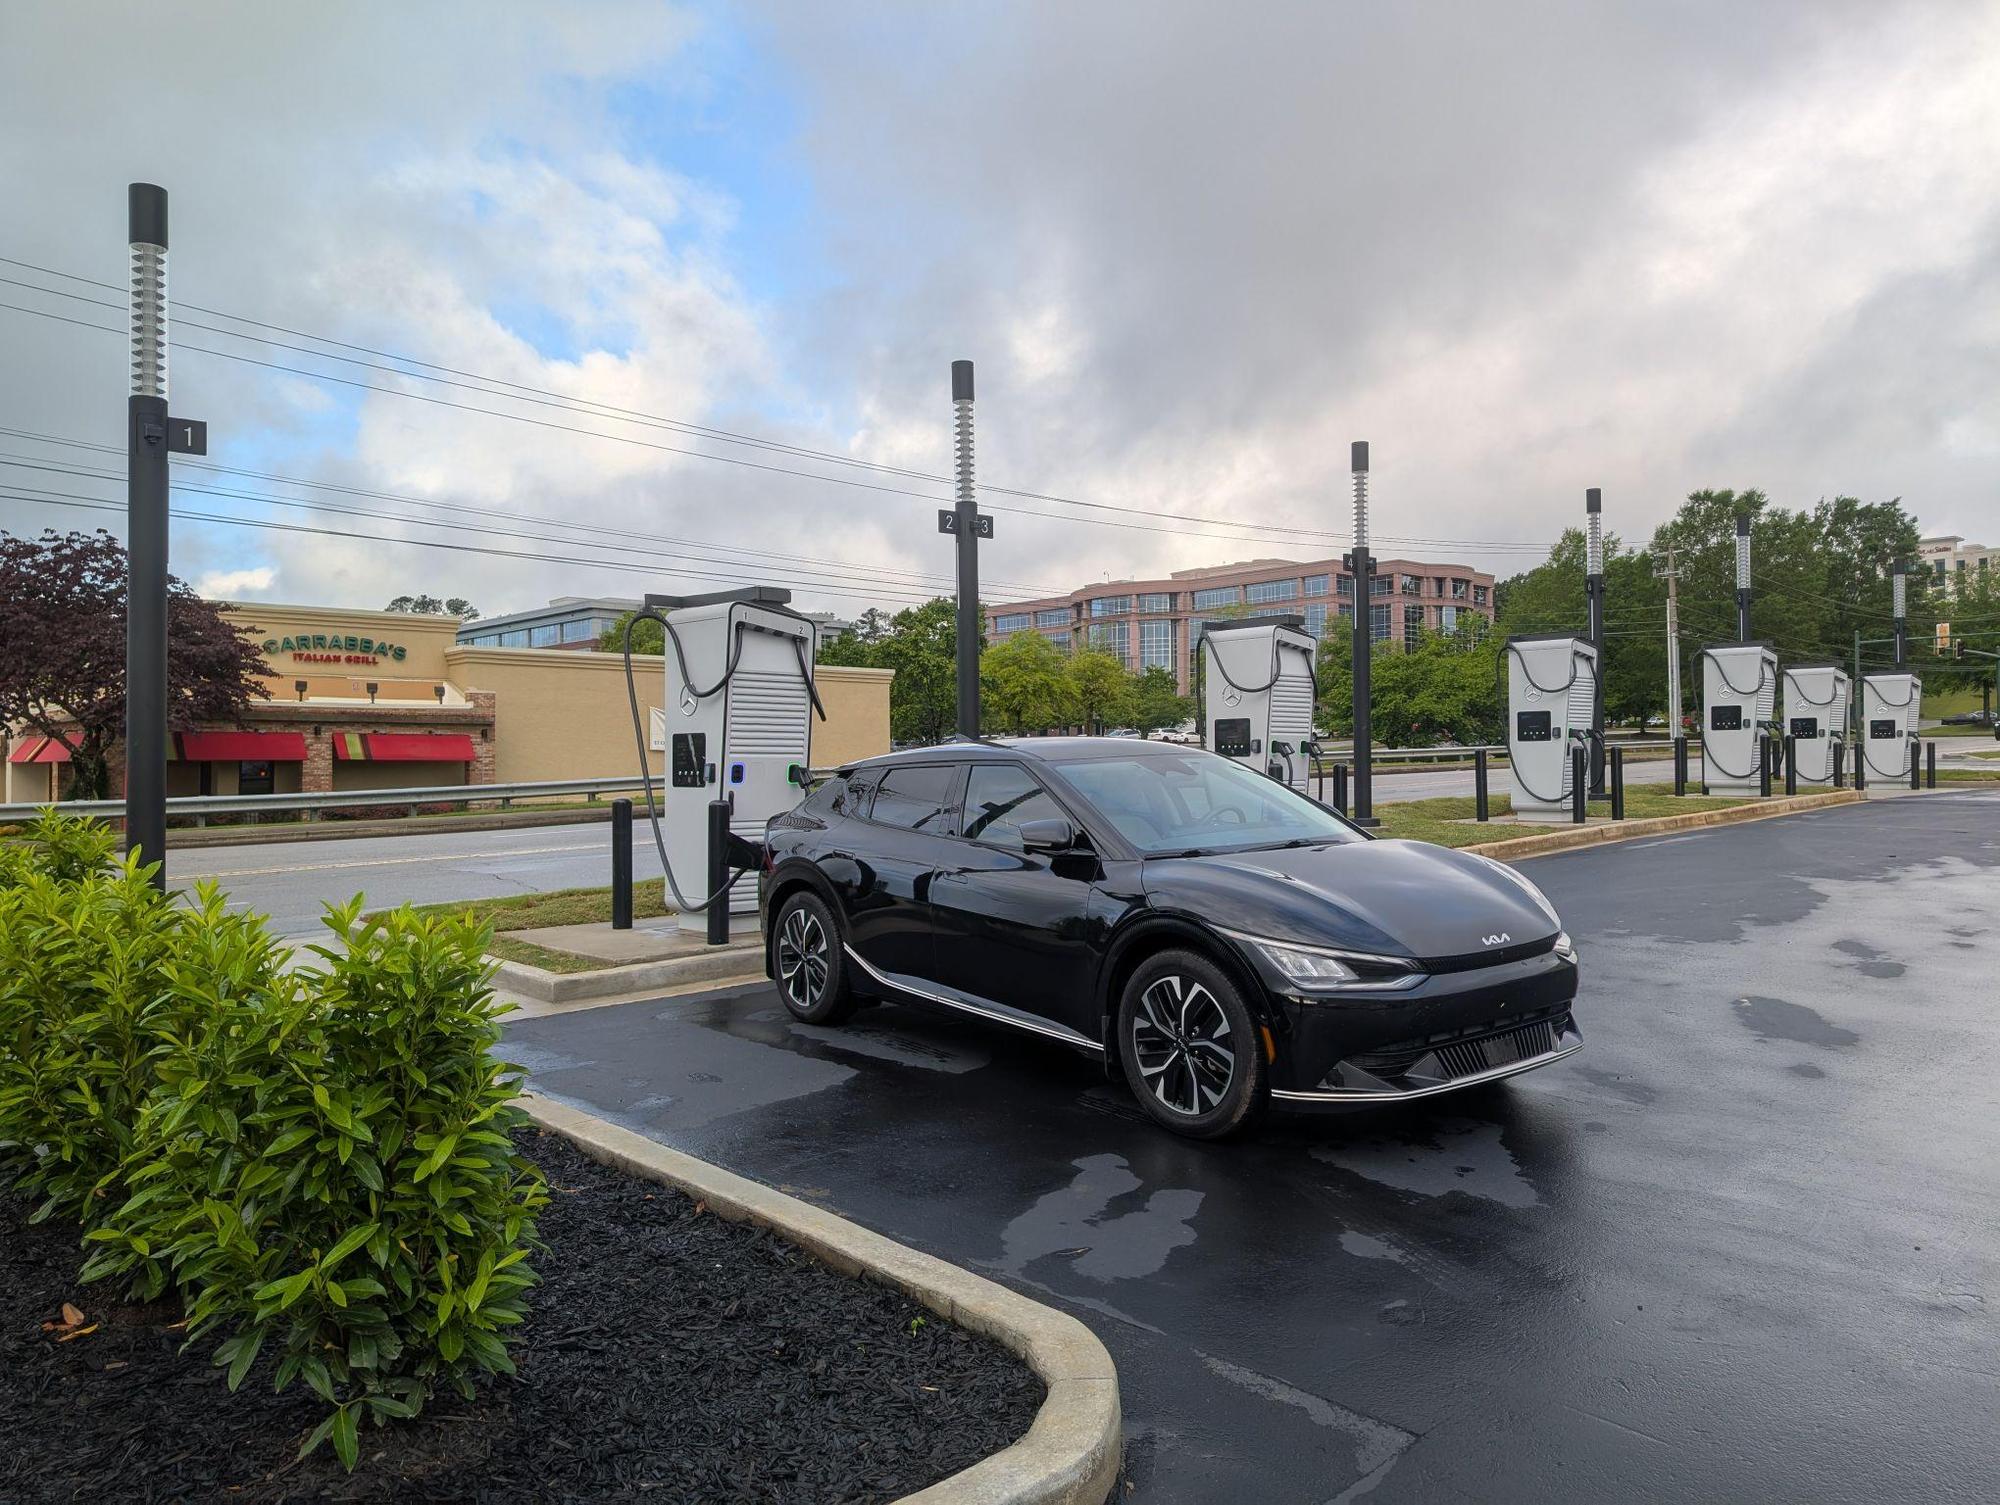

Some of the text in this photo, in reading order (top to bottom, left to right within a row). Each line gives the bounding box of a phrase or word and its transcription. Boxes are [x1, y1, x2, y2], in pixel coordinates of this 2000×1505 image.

[184, 426, 192, 447] 1
[945, 514, 953, 530] 2
[981, 519, 989, 534] 3
[1347, 557, 1354, 569] 4
[263, 634, 407, 661] CARRABBA'S
[292, 652, 380, 666] ITALIAN GRILL
